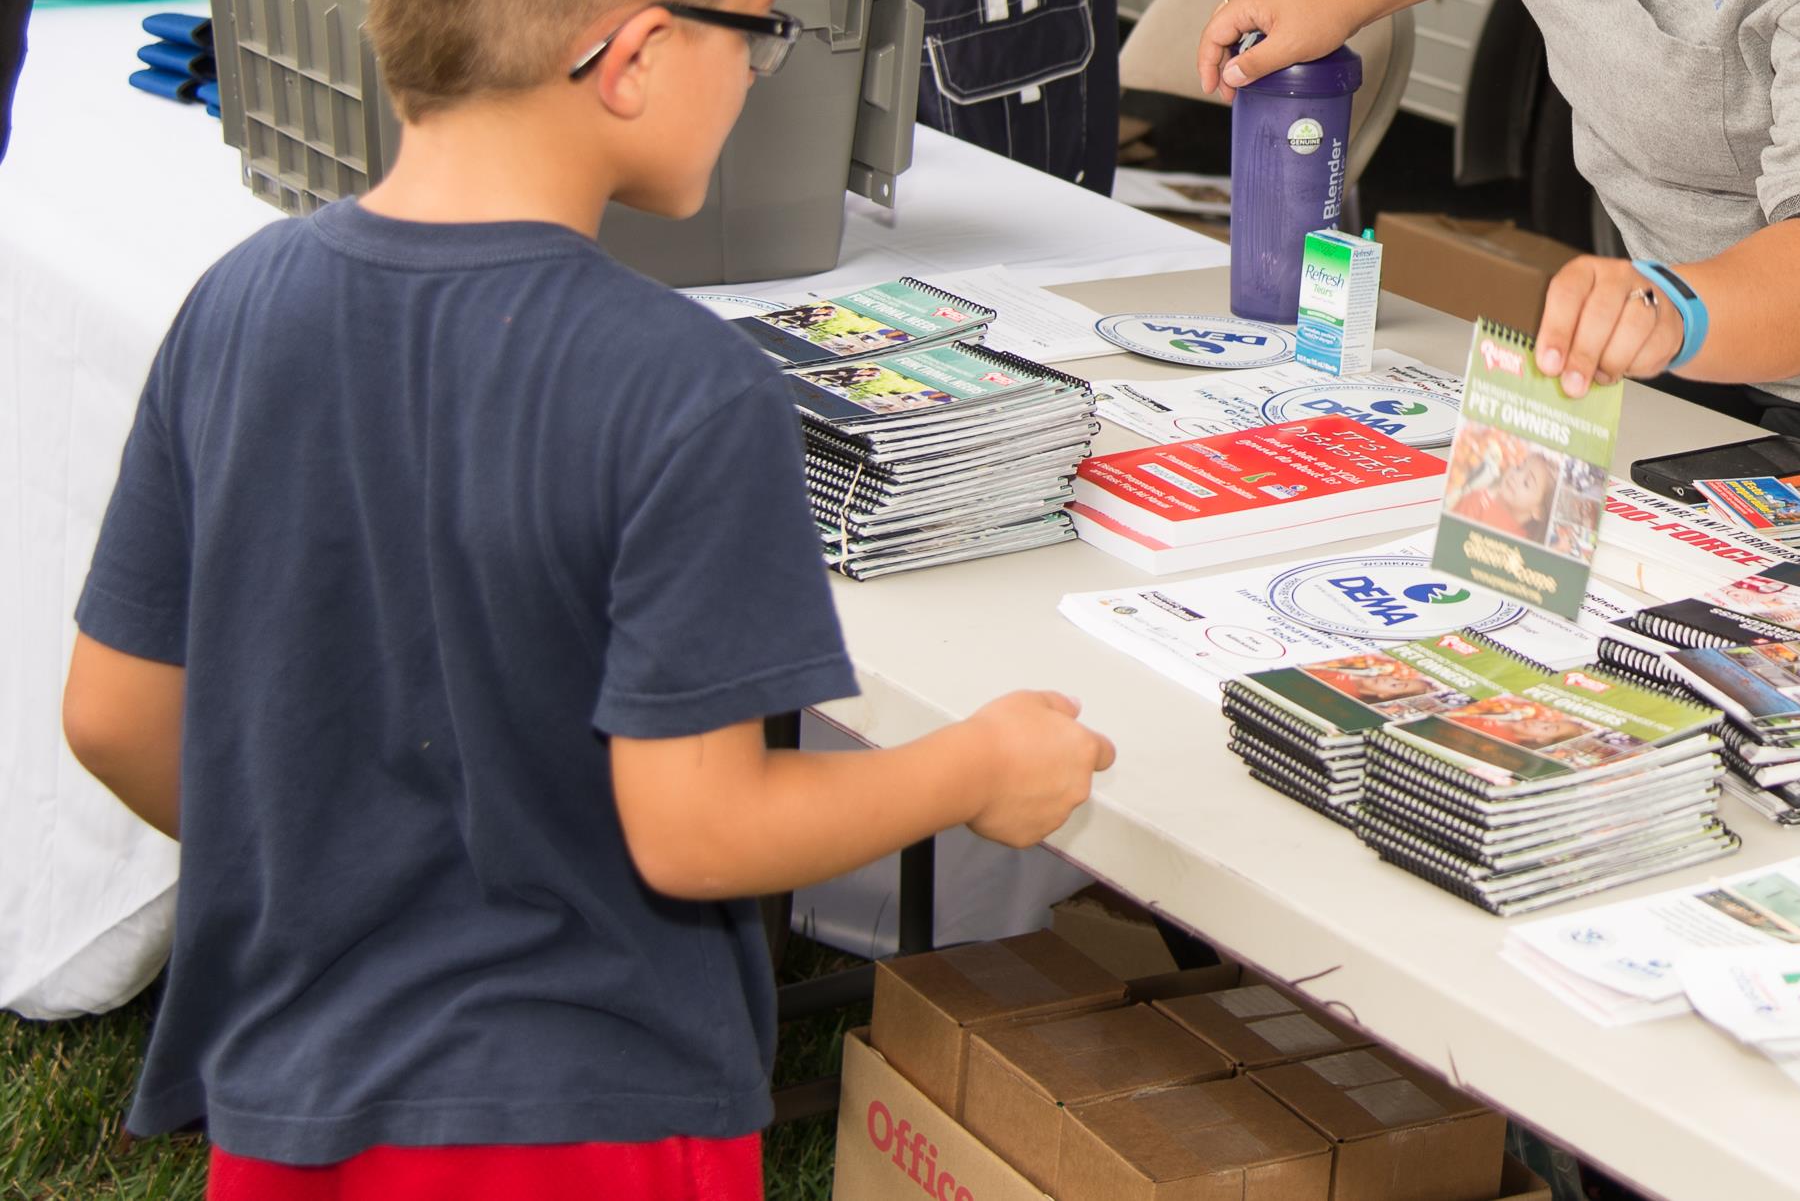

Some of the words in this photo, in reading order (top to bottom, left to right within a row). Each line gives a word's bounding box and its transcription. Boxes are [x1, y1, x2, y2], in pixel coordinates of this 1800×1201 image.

[1289, 138, 1321, 147] GENUINE
[1323, 137, 1343, 220] Blender
[1305, 263, 1346, 289] Refresh
[1313, 283, 1333, 298] Tears
[1142, 322, 1268, 346] DEMA
[1301, 398, 1407, 436] DEMA
[1467, 392, 1500, 420] PET
[1500, 404, 1572, 447] OWNERS
[1288, 444, 1319, 464] what
[1315, 459, 1337, 472] are
[1332, 430, 1387, 452] IT'S
[1235, 439, 1278, 458] gonna
[1275, 454, 1293, 464] do
[1290, 460, 1325, 480] about
[1615, 487, 1693, 519] DELAWARE
[1604, 495, 1776, 570] 00-FORCE-
[1326, 575, 1420, 628] DEMA
[1265, 626, 1302, 645] Food
[1266, 614, 1335, 650] Giveaways
[1391, 645, 1427, 660] PET
[1416, 658, 1477, 689] OWNERS
[1522, 686, 1555, 703] PET
[1552, 698, 1628, 727] OWNERS
